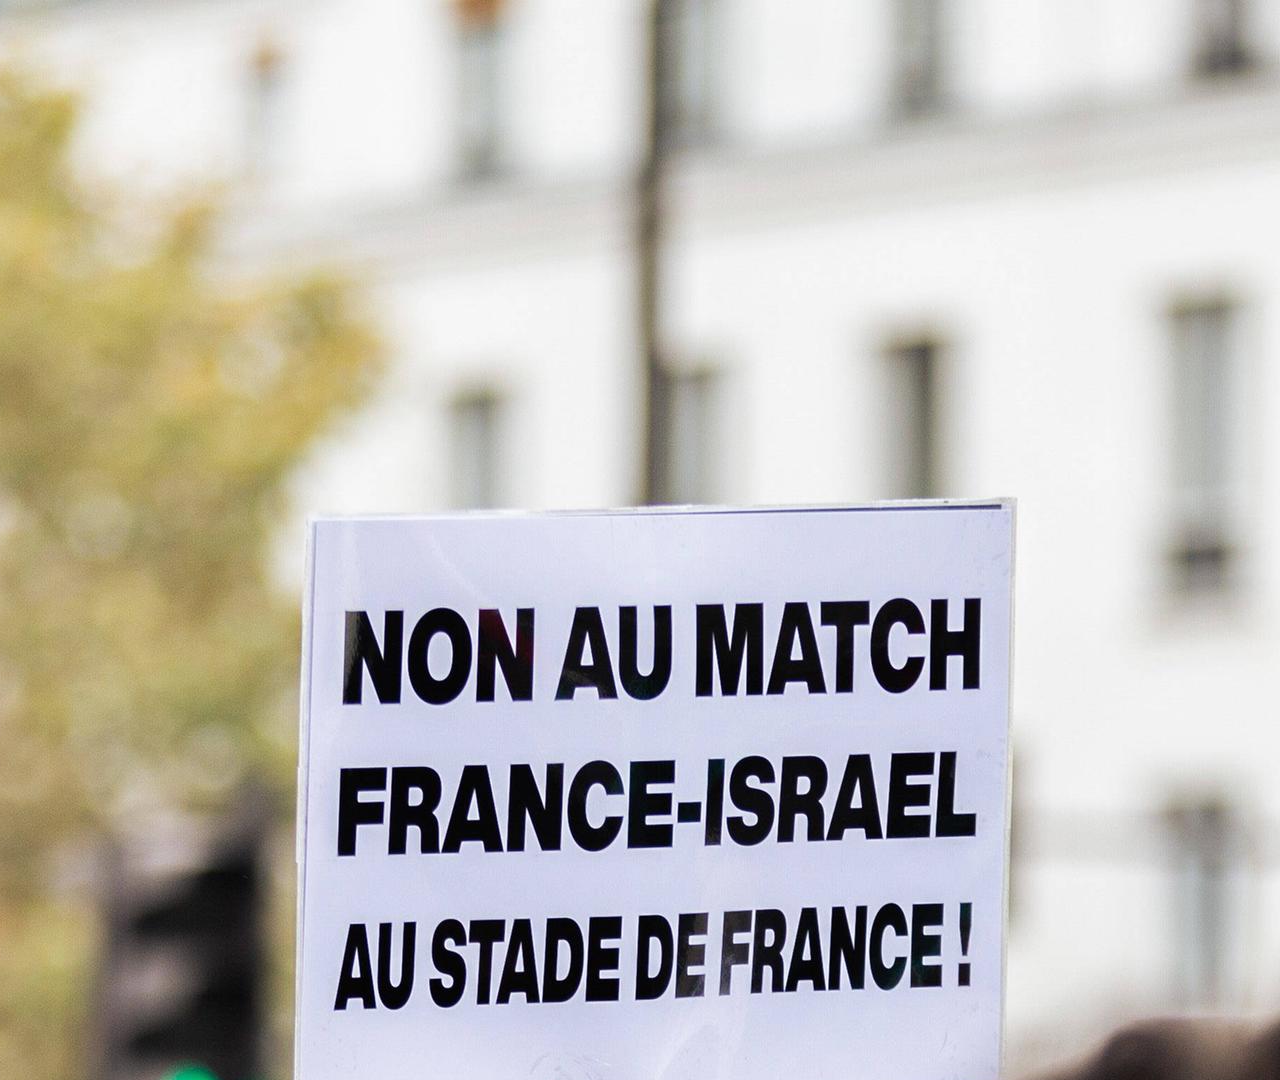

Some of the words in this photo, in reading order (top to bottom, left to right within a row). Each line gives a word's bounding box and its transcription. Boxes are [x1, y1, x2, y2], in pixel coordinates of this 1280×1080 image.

[342, 607, 535, 706] NON
[554, 604, 673, 701] AU
[695, 597, 983, 698] MATCH
[336, 751, 978, 858] FRANCE-ISRAEL
[333, 921, 417, 1011] AU
[428, 915, 623, 1009] STADE
[634, 912, 709, 1001] DE
[718, 902, 945, 996] FRANCE
